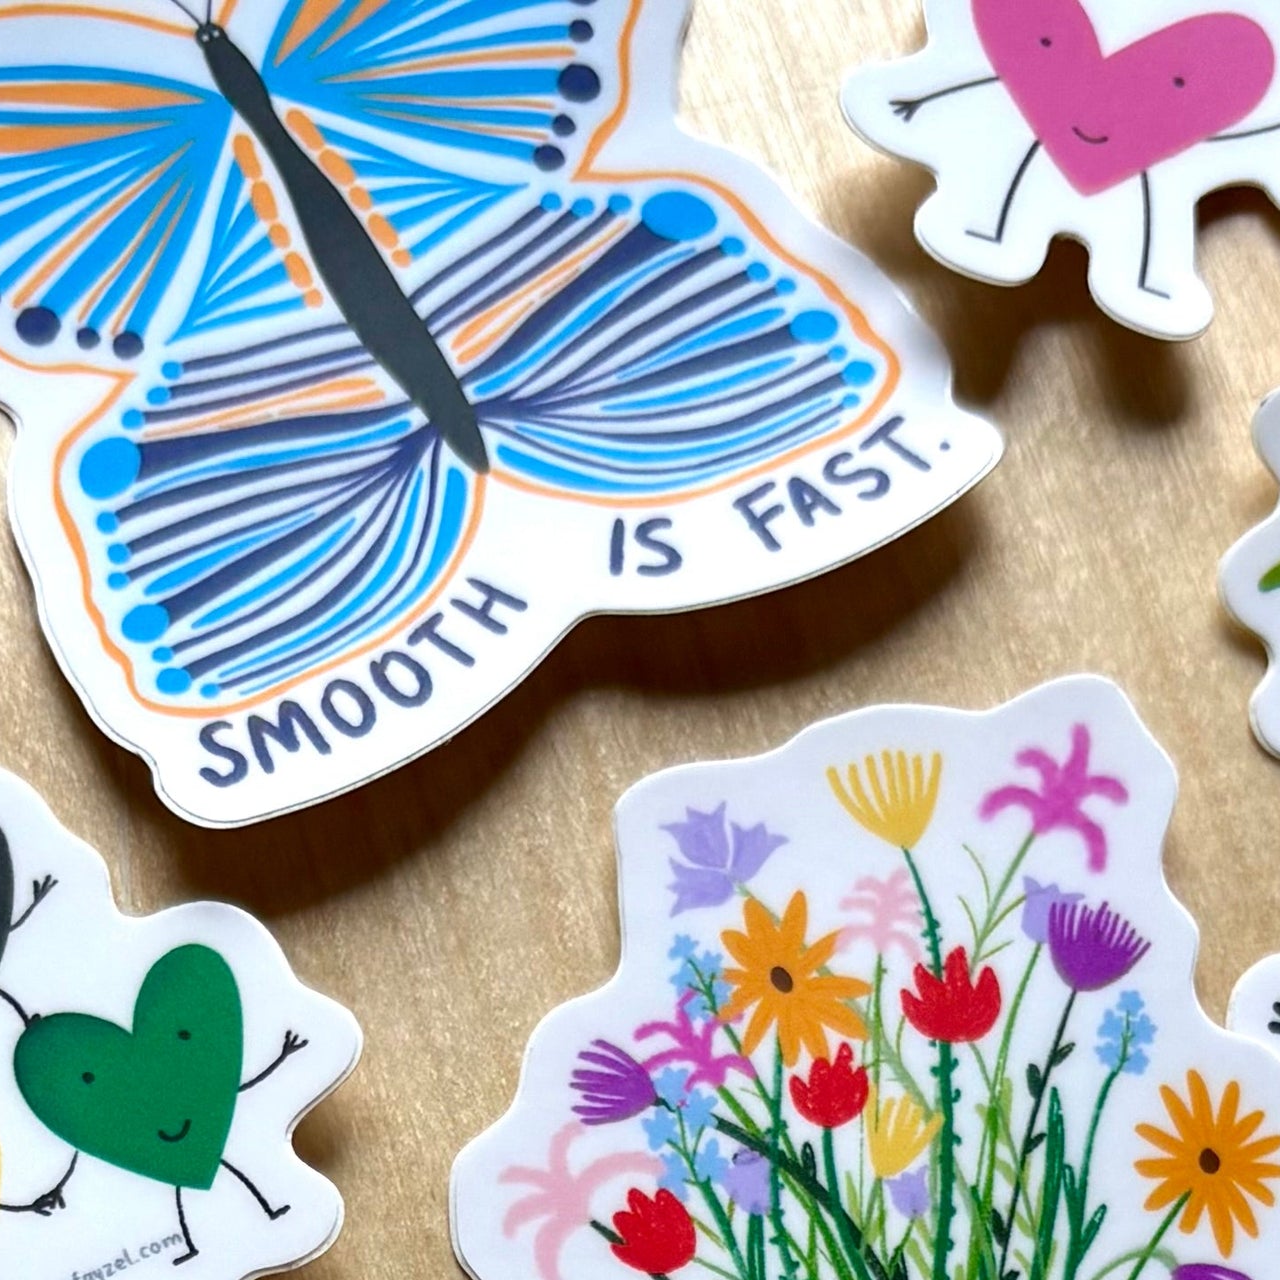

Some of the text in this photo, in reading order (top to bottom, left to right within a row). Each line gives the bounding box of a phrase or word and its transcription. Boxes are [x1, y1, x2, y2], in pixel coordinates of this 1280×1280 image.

[198, 416, 952, 788] SMOOTH IS FAST.
